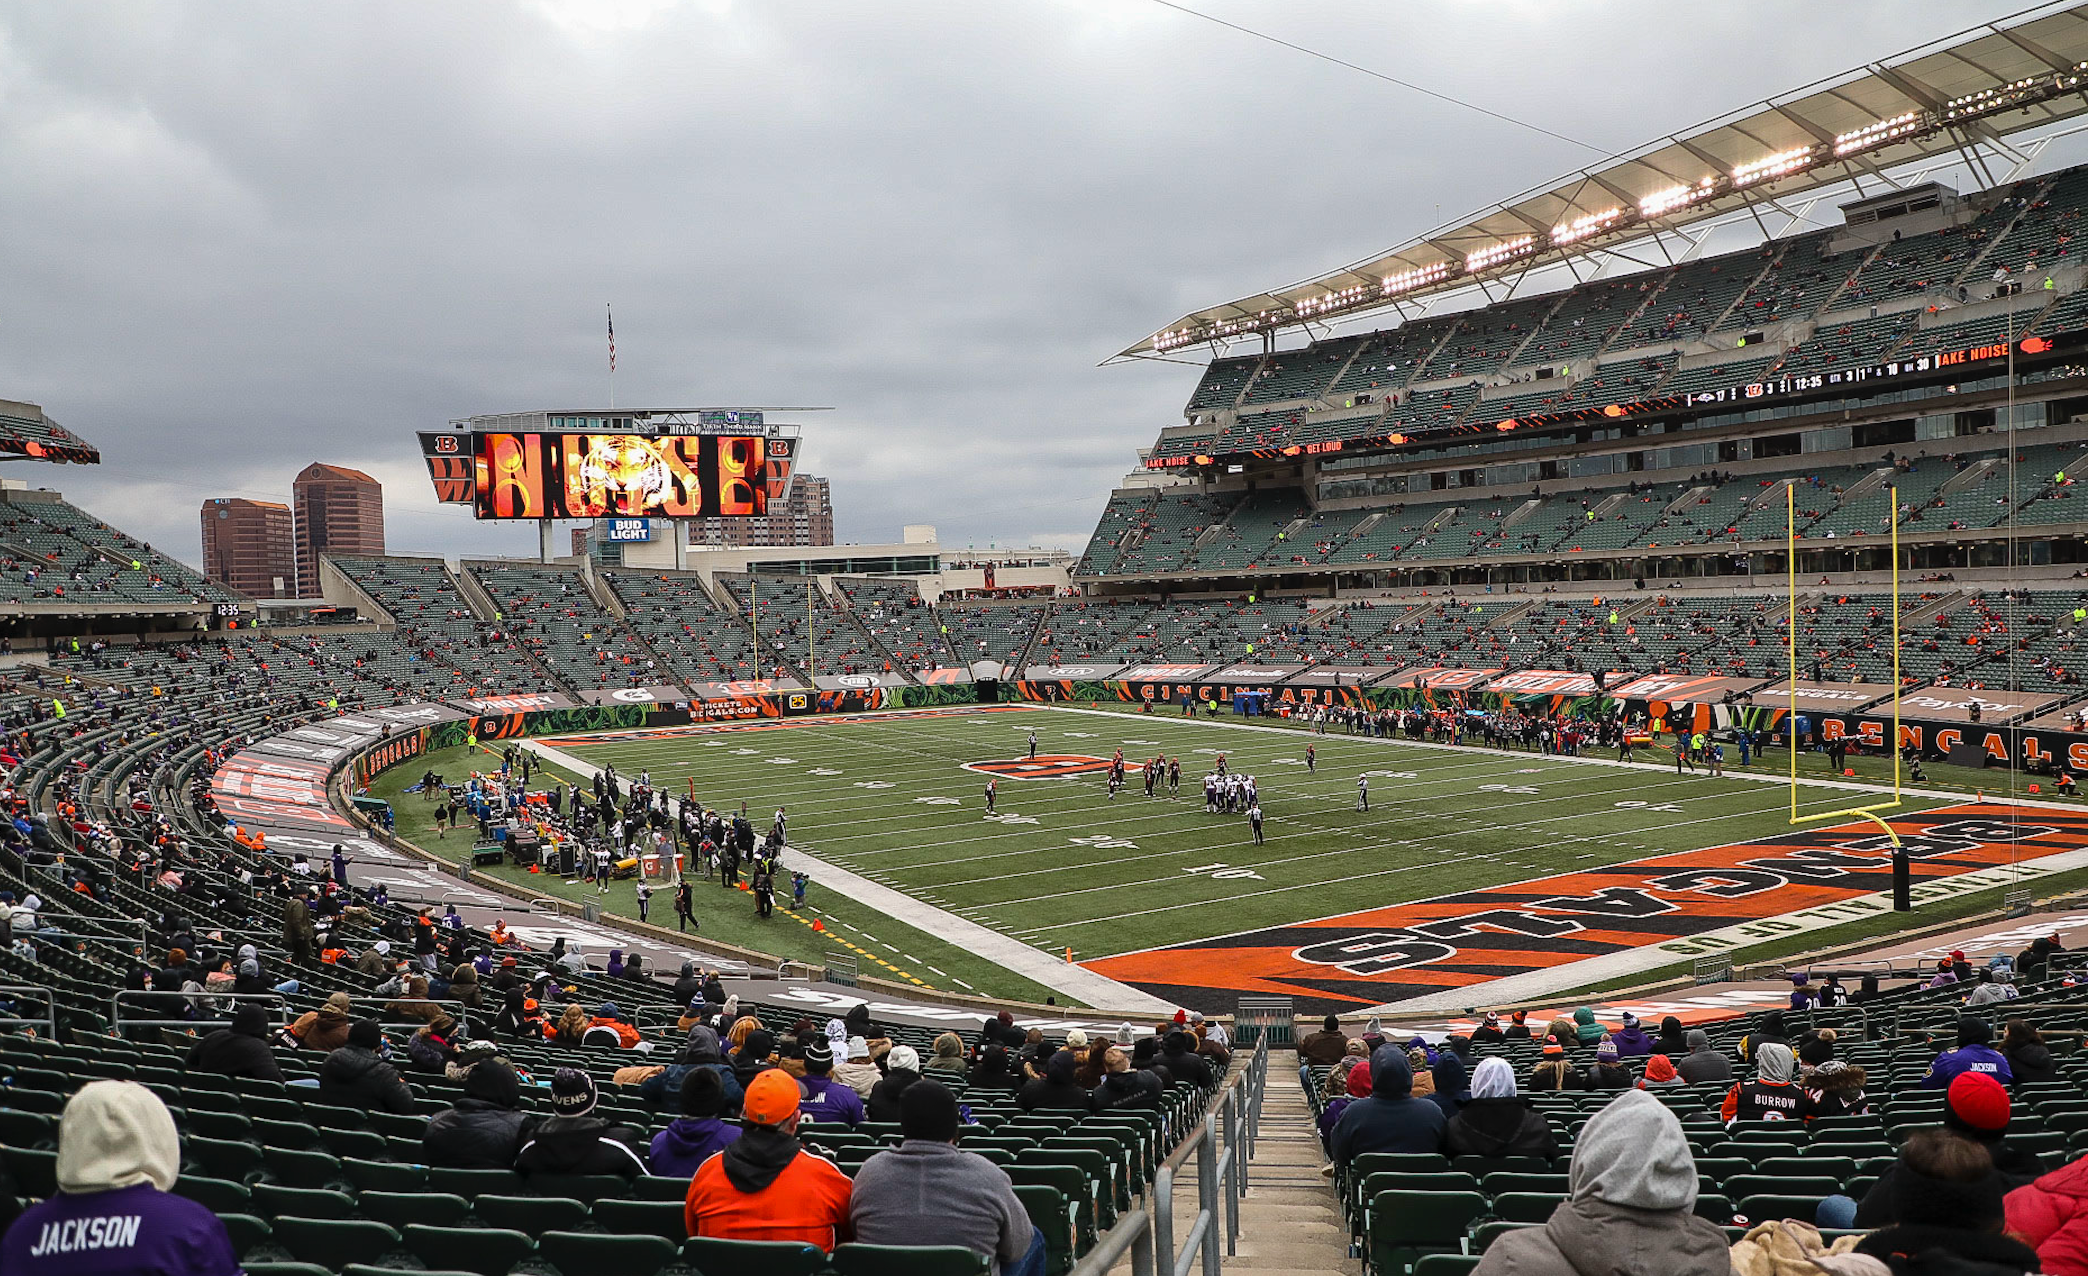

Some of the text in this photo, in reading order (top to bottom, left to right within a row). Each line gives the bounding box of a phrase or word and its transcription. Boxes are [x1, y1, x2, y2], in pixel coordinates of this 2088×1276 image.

[1971, 343, 2009, 360] NOISE
[1887, 363, 1898, 376] 10
[1917, 358, 1929, 371] 30
[1846, 371, 1853, 381] 3
[1767, 383, 1774, 394] 3
[1795, 377, 1822, 390] 12:35
[1716, 390, 1725, 401] 17
[1307, 442, 1342, 454] GET LOUD
[1166, 457, 1189, 467] NOISE
[615, 519, 642, 531] BUD
[611, 529, 648, 541] LIGHT
[217, 605, 239, 616] 12:35
[1615, 681, 1687, 695] DEY
[791, 696, 805, 707] 25
[1761, 690, 1871, 700] BENGALS
[466, 696, 555, 709] WHO DEY
[1822, 718, 2088, 771] BENGALS
[369, 735, 418, 776] BENGALS
[1291, 820, 2060, 977] BENGALS
[1800, 900, 1885, 920] ALL
[1740, 921, 1800, 938] OF
[1659, 937, 1736, 955] US
[1833, 995, 1847, 1007] 20
[1970, 1062, 1998, 1073] JACKSON
[1755, 1093, 1796, 1109] BURROW
[31, 1216, 142, 1257] JACKSON
